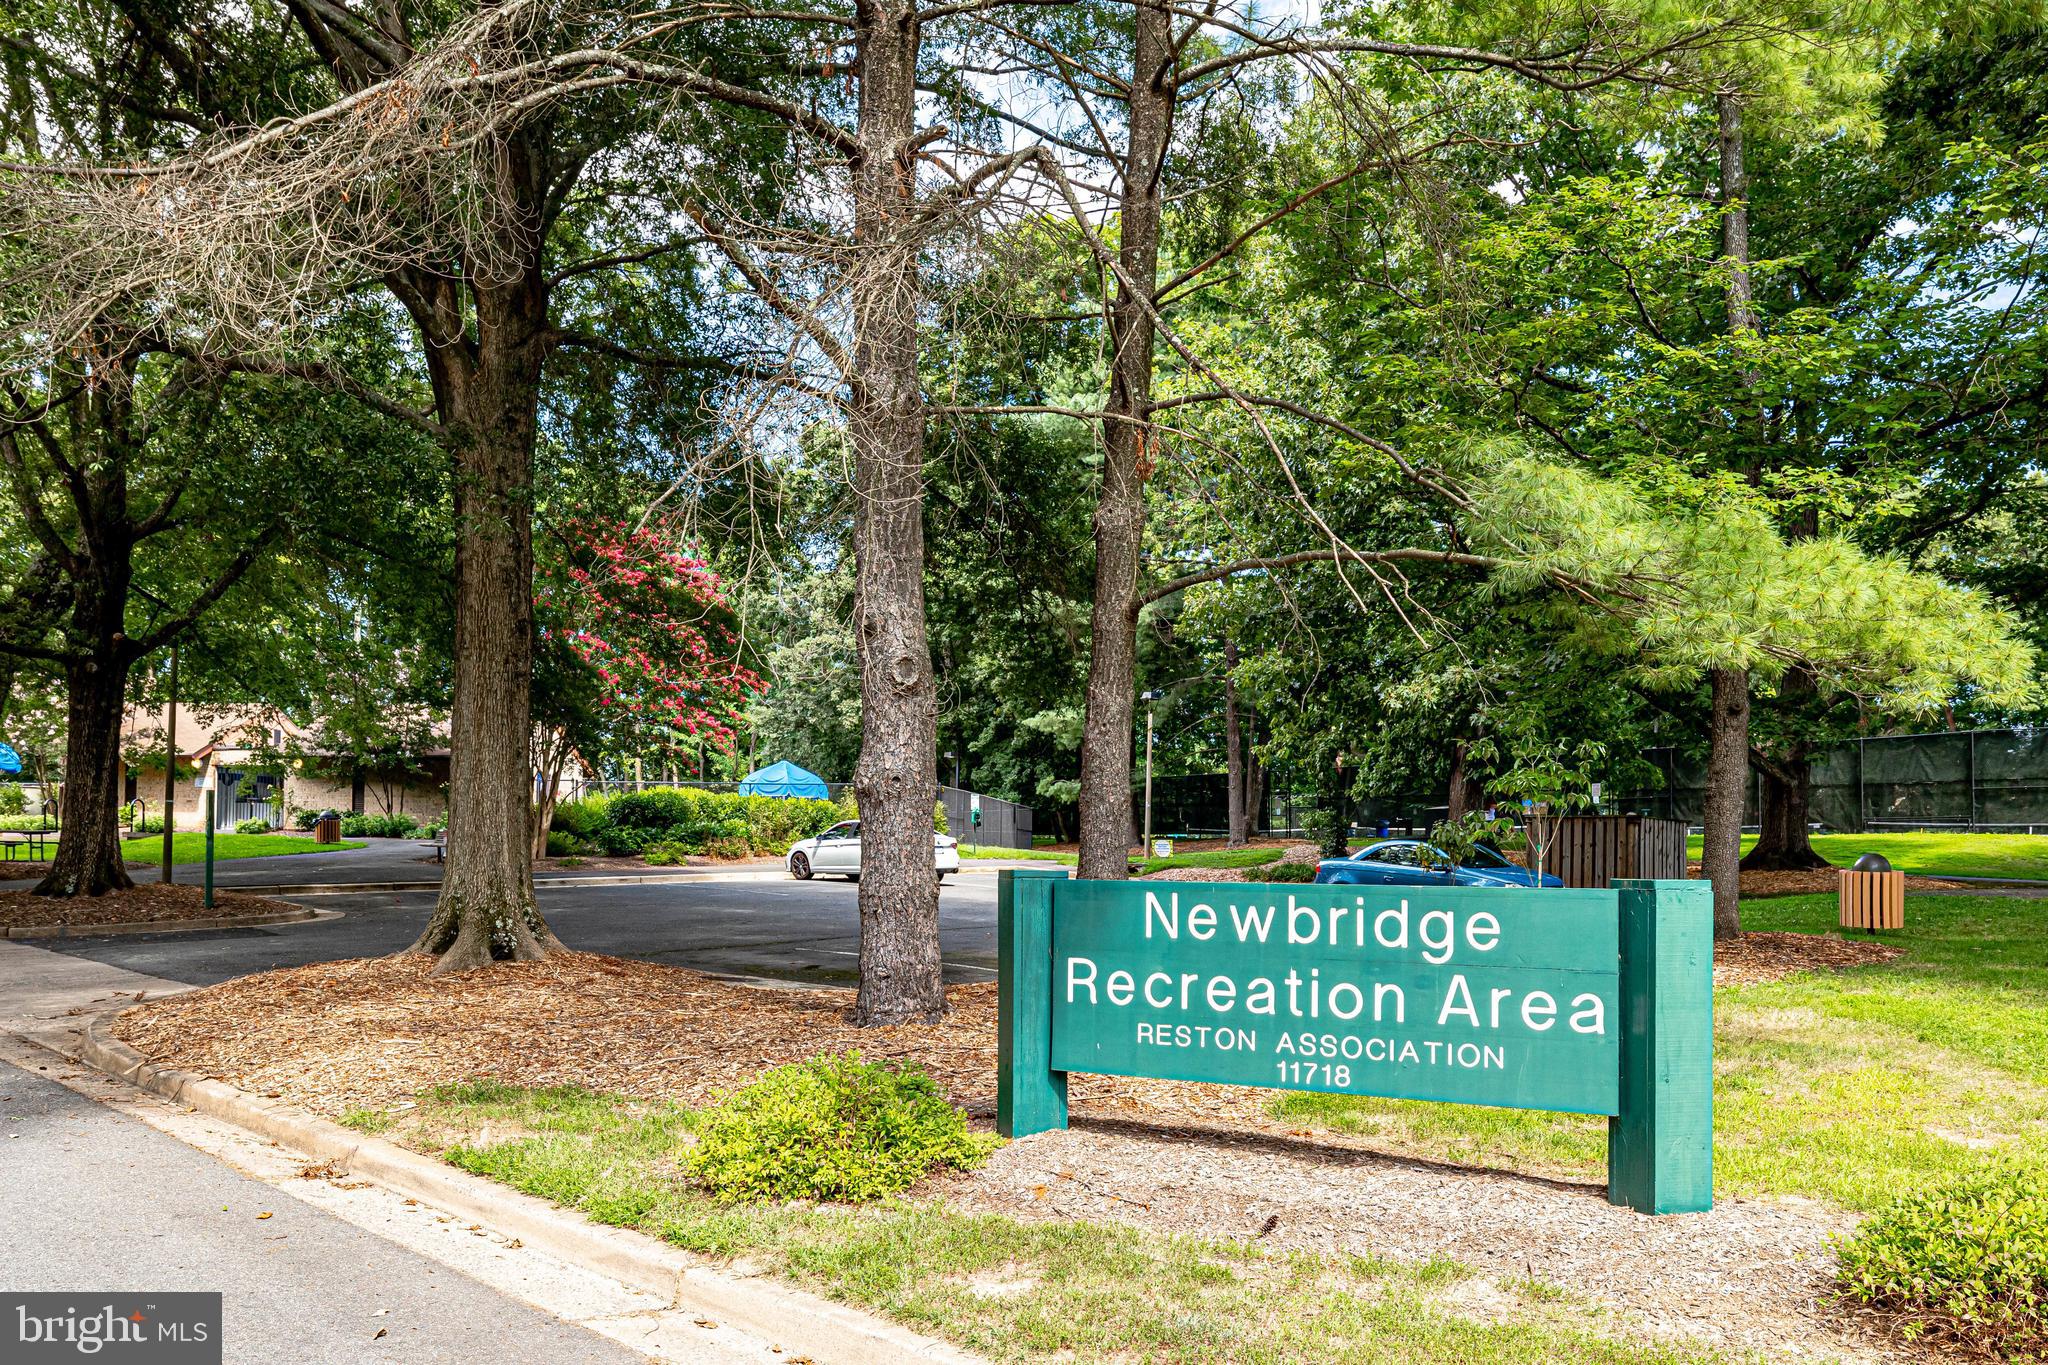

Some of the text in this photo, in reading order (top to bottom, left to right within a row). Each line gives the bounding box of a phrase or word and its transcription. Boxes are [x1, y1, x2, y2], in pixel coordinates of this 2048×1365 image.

[1145, 891, 1501, 966] Newbridge
[1066, 957, 1606, 1035] Recreation Area
[1137, 1022, 1505, 1070] RESTON ASSOCIATION
[1276, 1060, 1351, 1088] 11718
